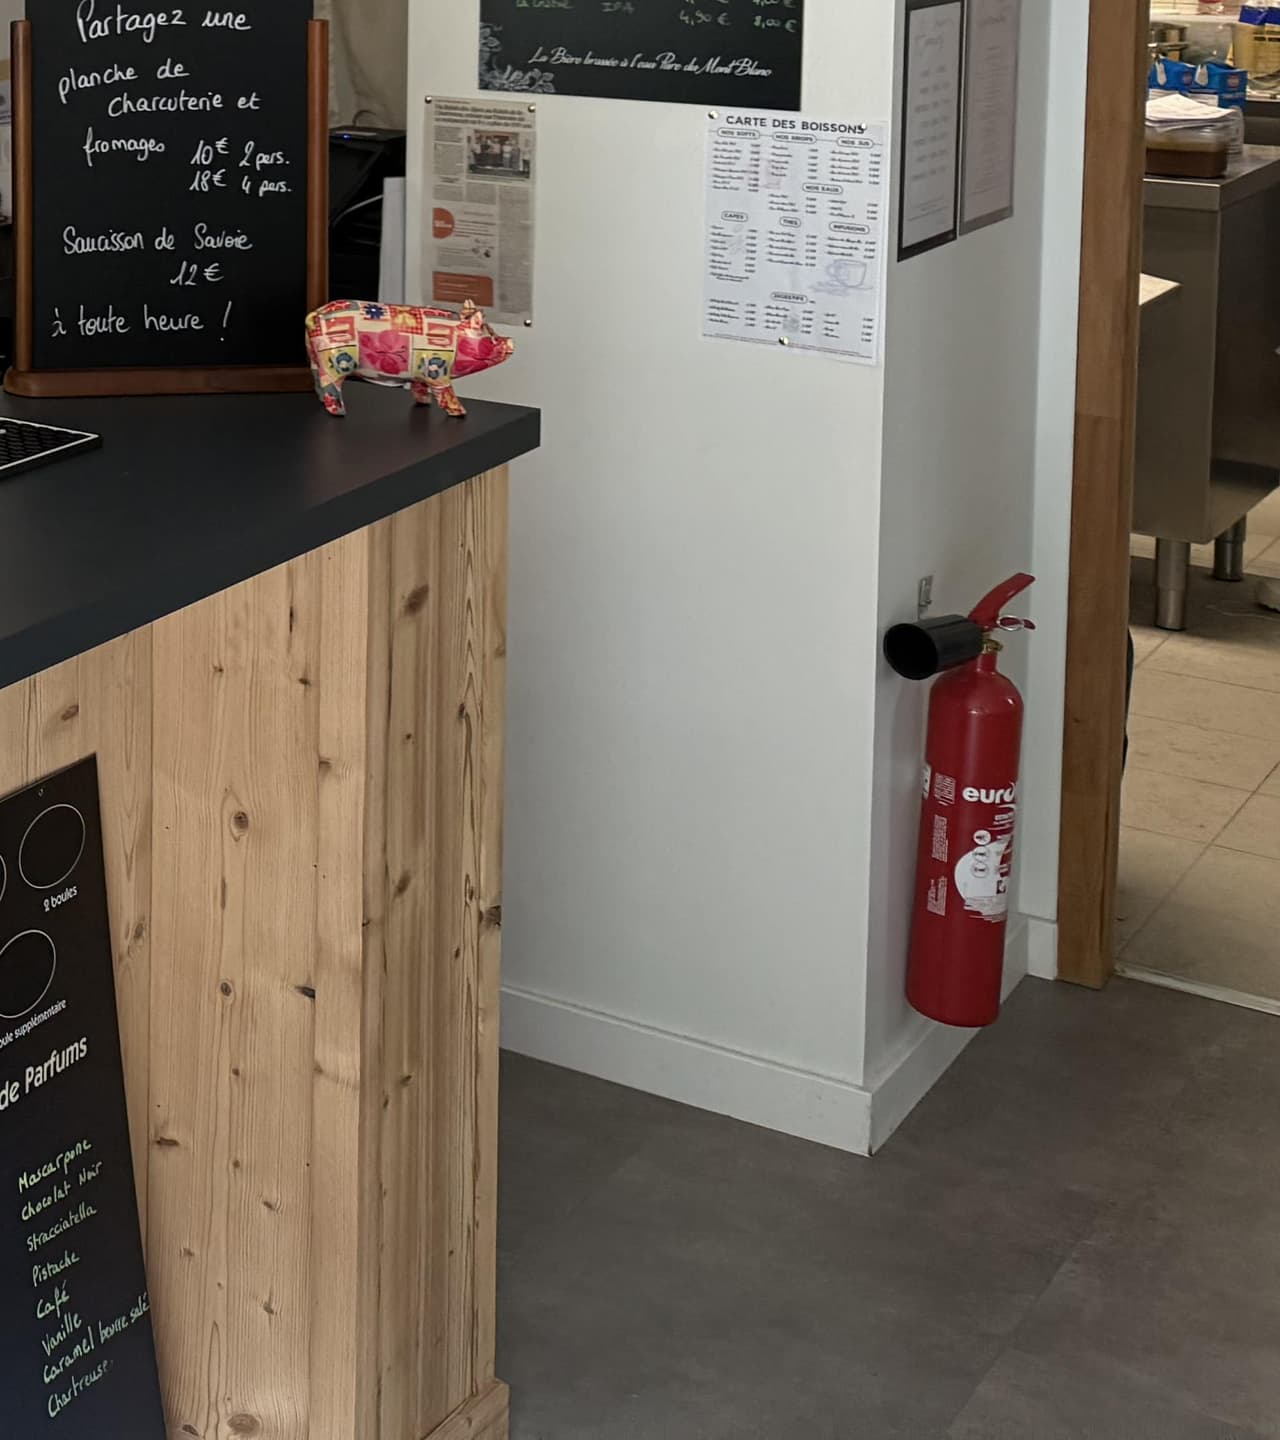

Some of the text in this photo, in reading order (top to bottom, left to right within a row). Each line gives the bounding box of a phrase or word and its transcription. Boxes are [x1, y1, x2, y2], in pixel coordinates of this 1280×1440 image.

[201, 10, 251, 30] une
[58, 58, 190, 104] planche de
[550, 47, 583, 65] Bière
[696, 56, 735, 75] Mont
[733, 58, 773, 77] Blanc
[237, 92, 263, 110] et
[725, 115, 866, 135] CARTE DES BOISSONS
[82, 126, 165, 167] fromages
[239, 141, 254, 167] 2
[255, 150, 290, 171] pers.
[241, 175, 251, 194] 4
[258, 177, 293, 197] pers.
[62, 223, 254, 255] Saucisson de Savoie
[51, 300, 232, 341] à toute heure !
[50, 884, 79, 909] boules
[14, 997, 67, 1040] supplémentaire
[24, 1035, 89, 1096] Parfums
[17, 1136, 93, 1194] Mascarpone
[78, 1160, 104, 1187] Noir
[31, 1251, 81, 1288] Pistache
[36, 1278, 71, 1320] Café
[41, 1310, 83, 1357] Vanille
[42, 1326, 96, 1385] Caramel
